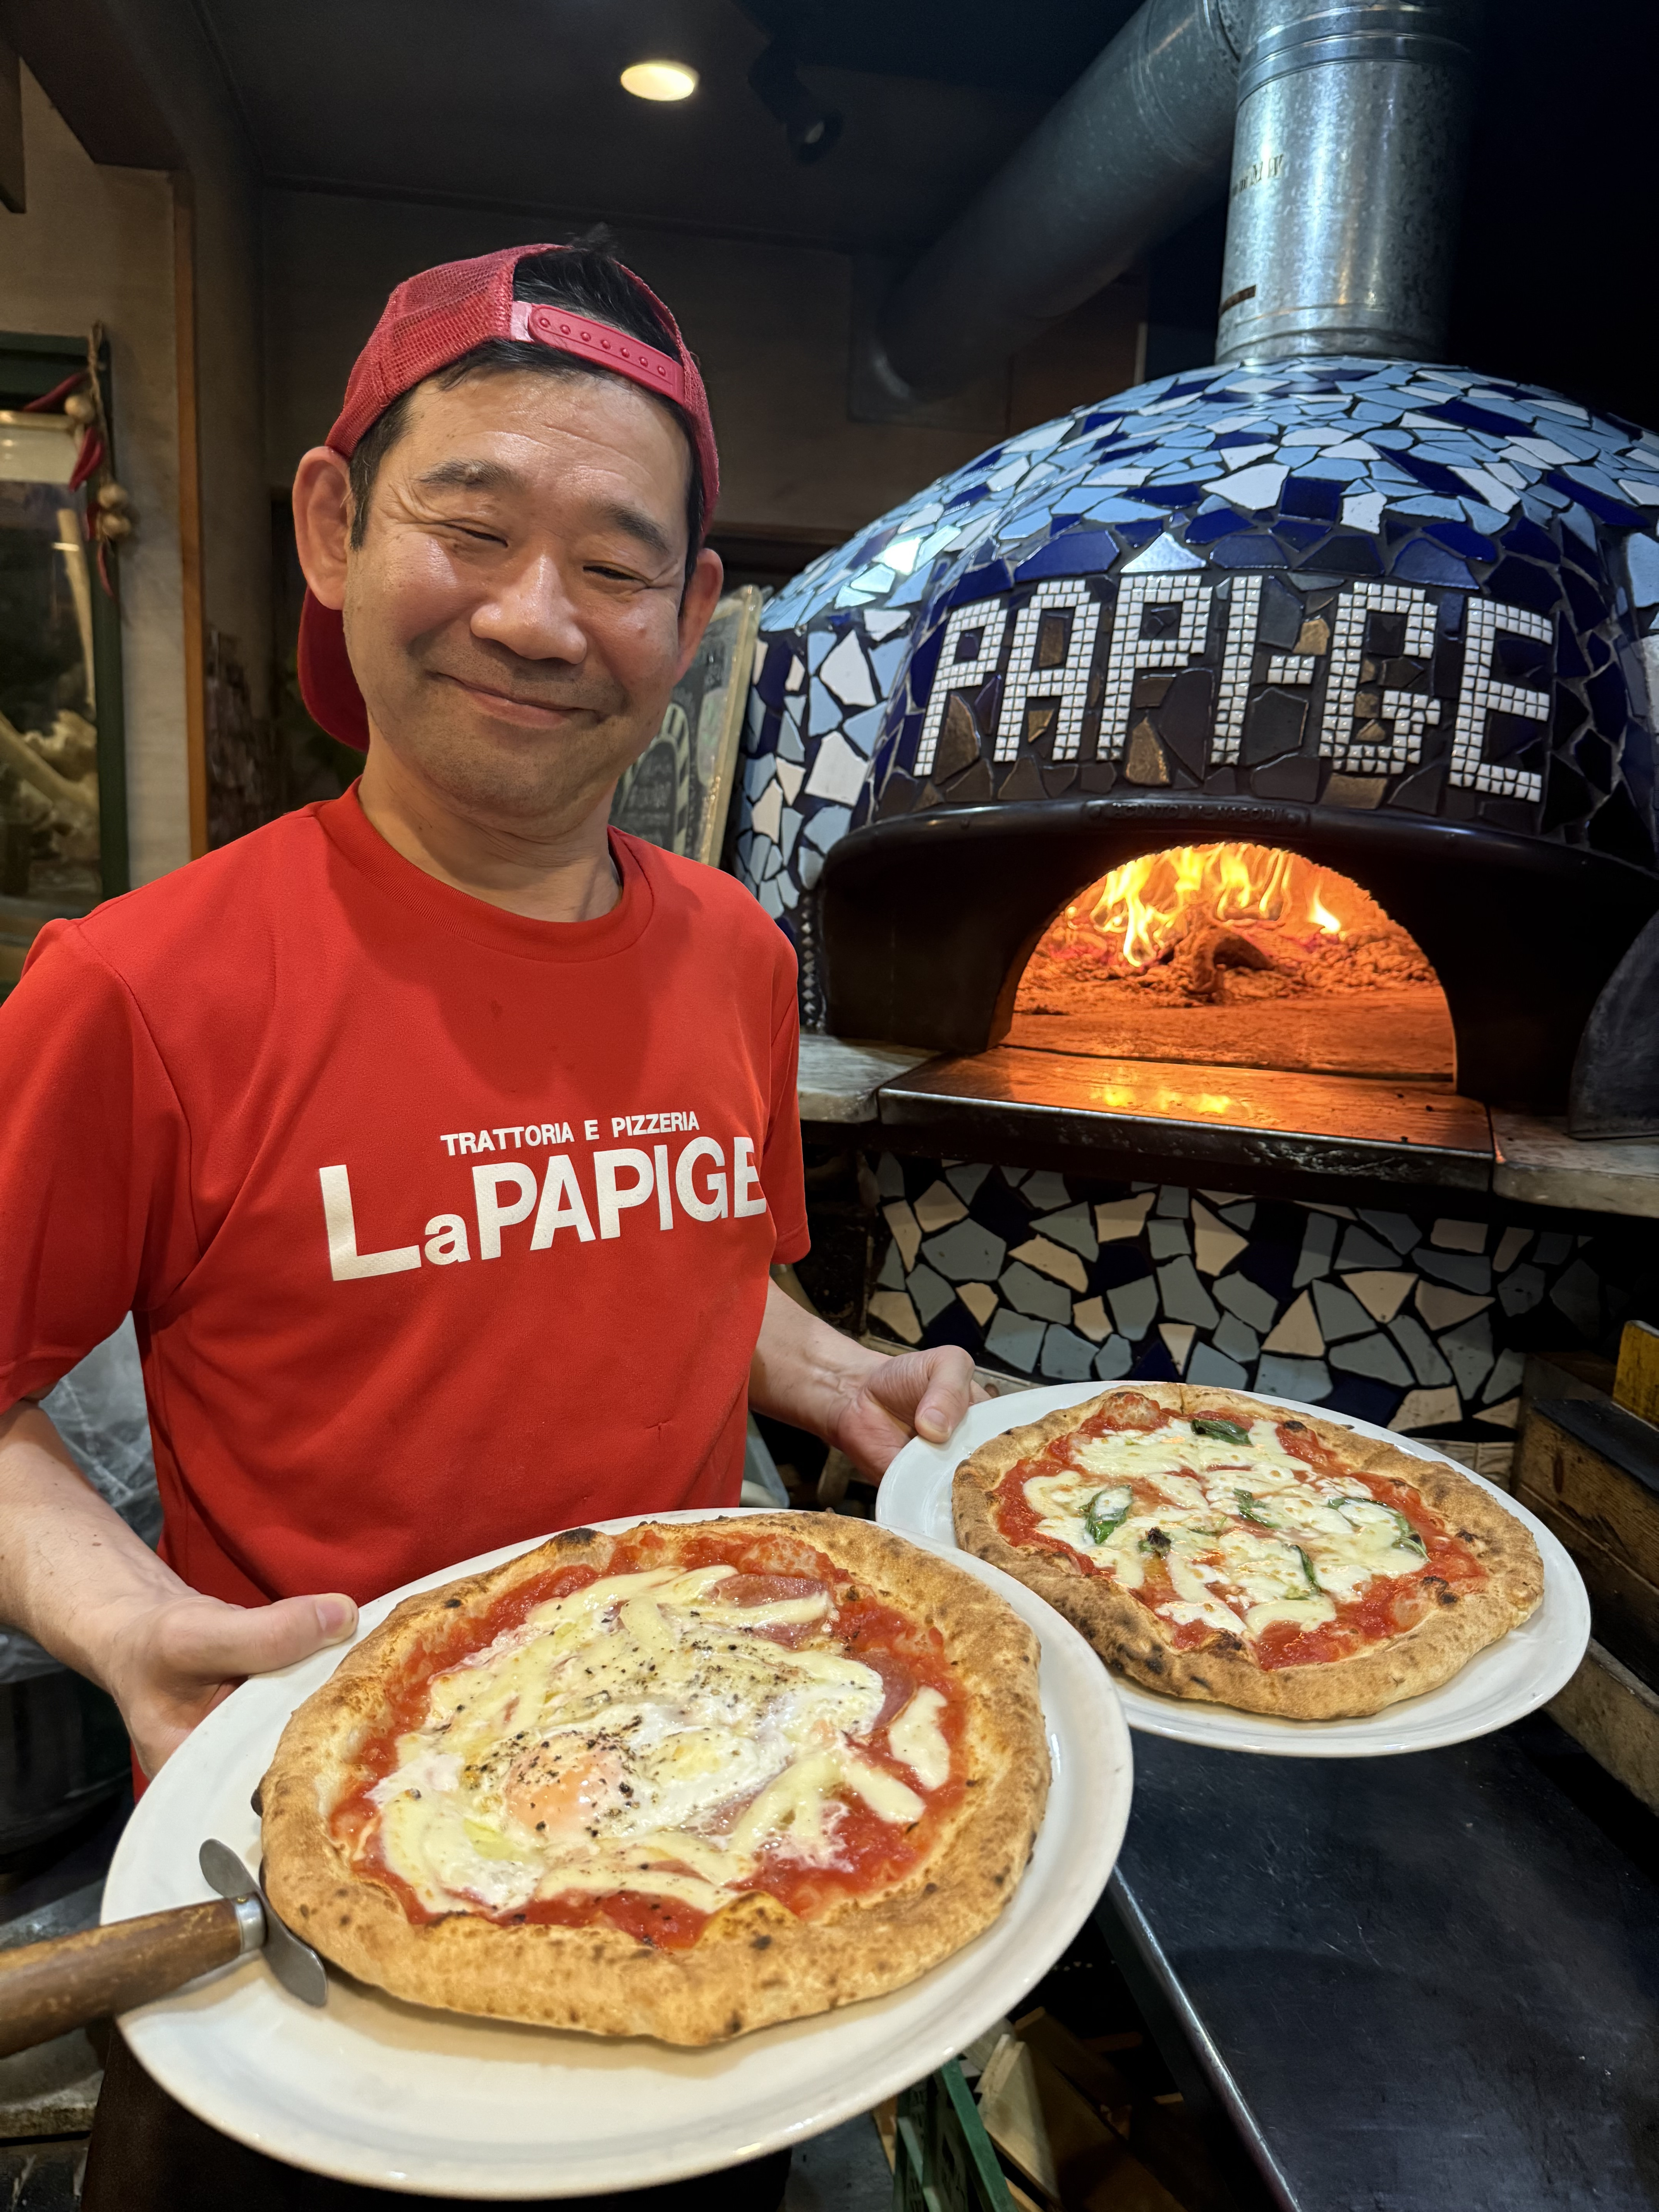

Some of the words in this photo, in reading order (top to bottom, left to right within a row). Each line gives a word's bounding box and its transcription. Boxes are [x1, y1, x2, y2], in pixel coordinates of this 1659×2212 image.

[440, 1122, 575, 1156] TRATTORIA
[584, 1119, 600, 1140] E
[611, 1111, 700, 1138] PIZZERIA
